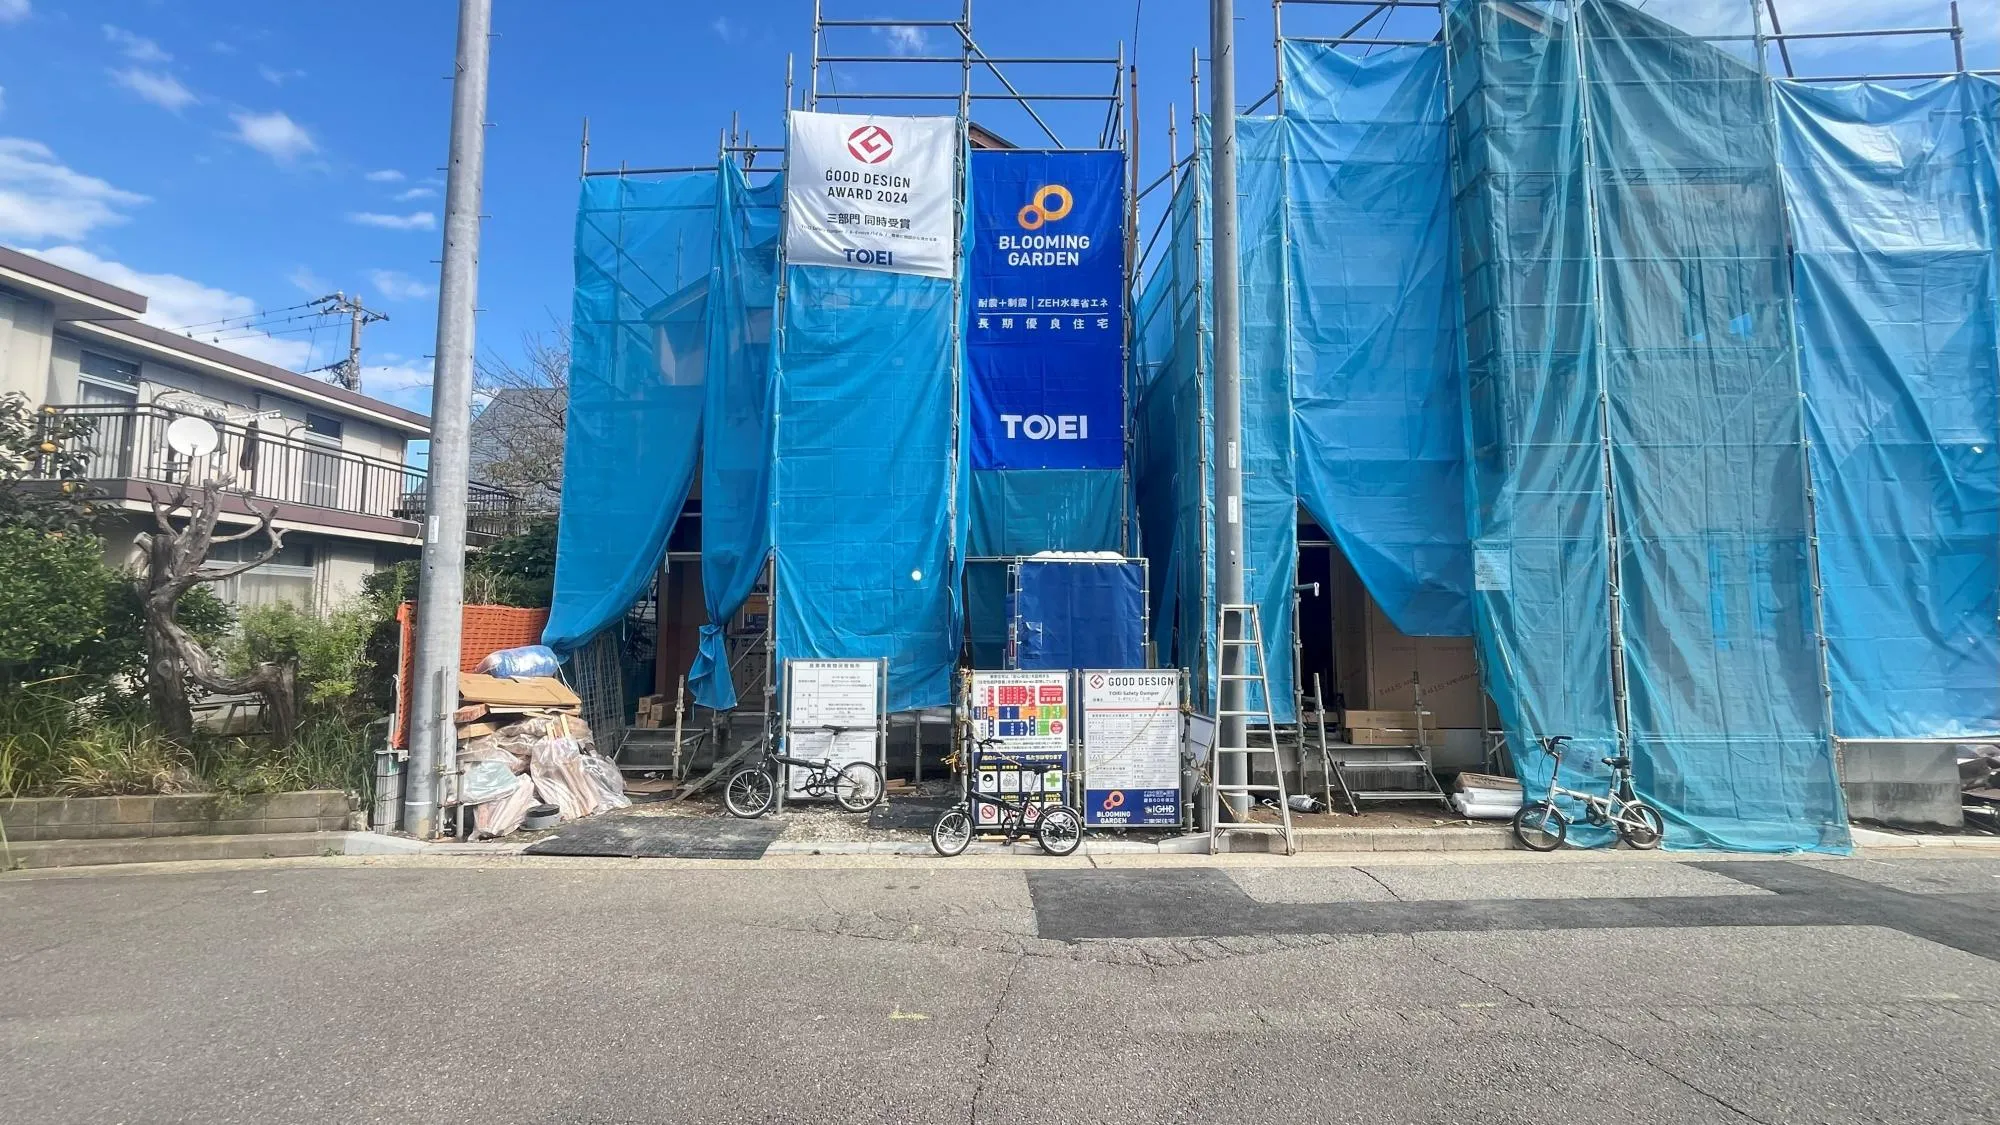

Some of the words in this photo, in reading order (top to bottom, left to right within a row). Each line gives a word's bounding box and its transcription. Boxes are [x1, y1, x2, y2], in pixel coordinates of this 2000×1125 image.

[825, 169, 860, 185] GOOD
[864, 174, 911, 189] DESIGN
[827, 186, 873, 201] AWARD
[877, 190, 909, 205] 2024
[826, 213, 860, 225] 三部門
[864, 215, 911, 230] 同時受賞
[999, 235, 1090, 251] BLOOMING
[1008, 250, 1079, 266] GARDEN
[1037, 298, 1109, 309] ZEH水準省エネ
[978, 317, 1109, 330] 長期優良住宅
[1108, 677, 1135, 687] GOOD
[1138, 677, 1174, 686] DESIGN
[1096, 810, 1131, 818] BLOOMING
[1152, 804, 1175, 814] IGHD
